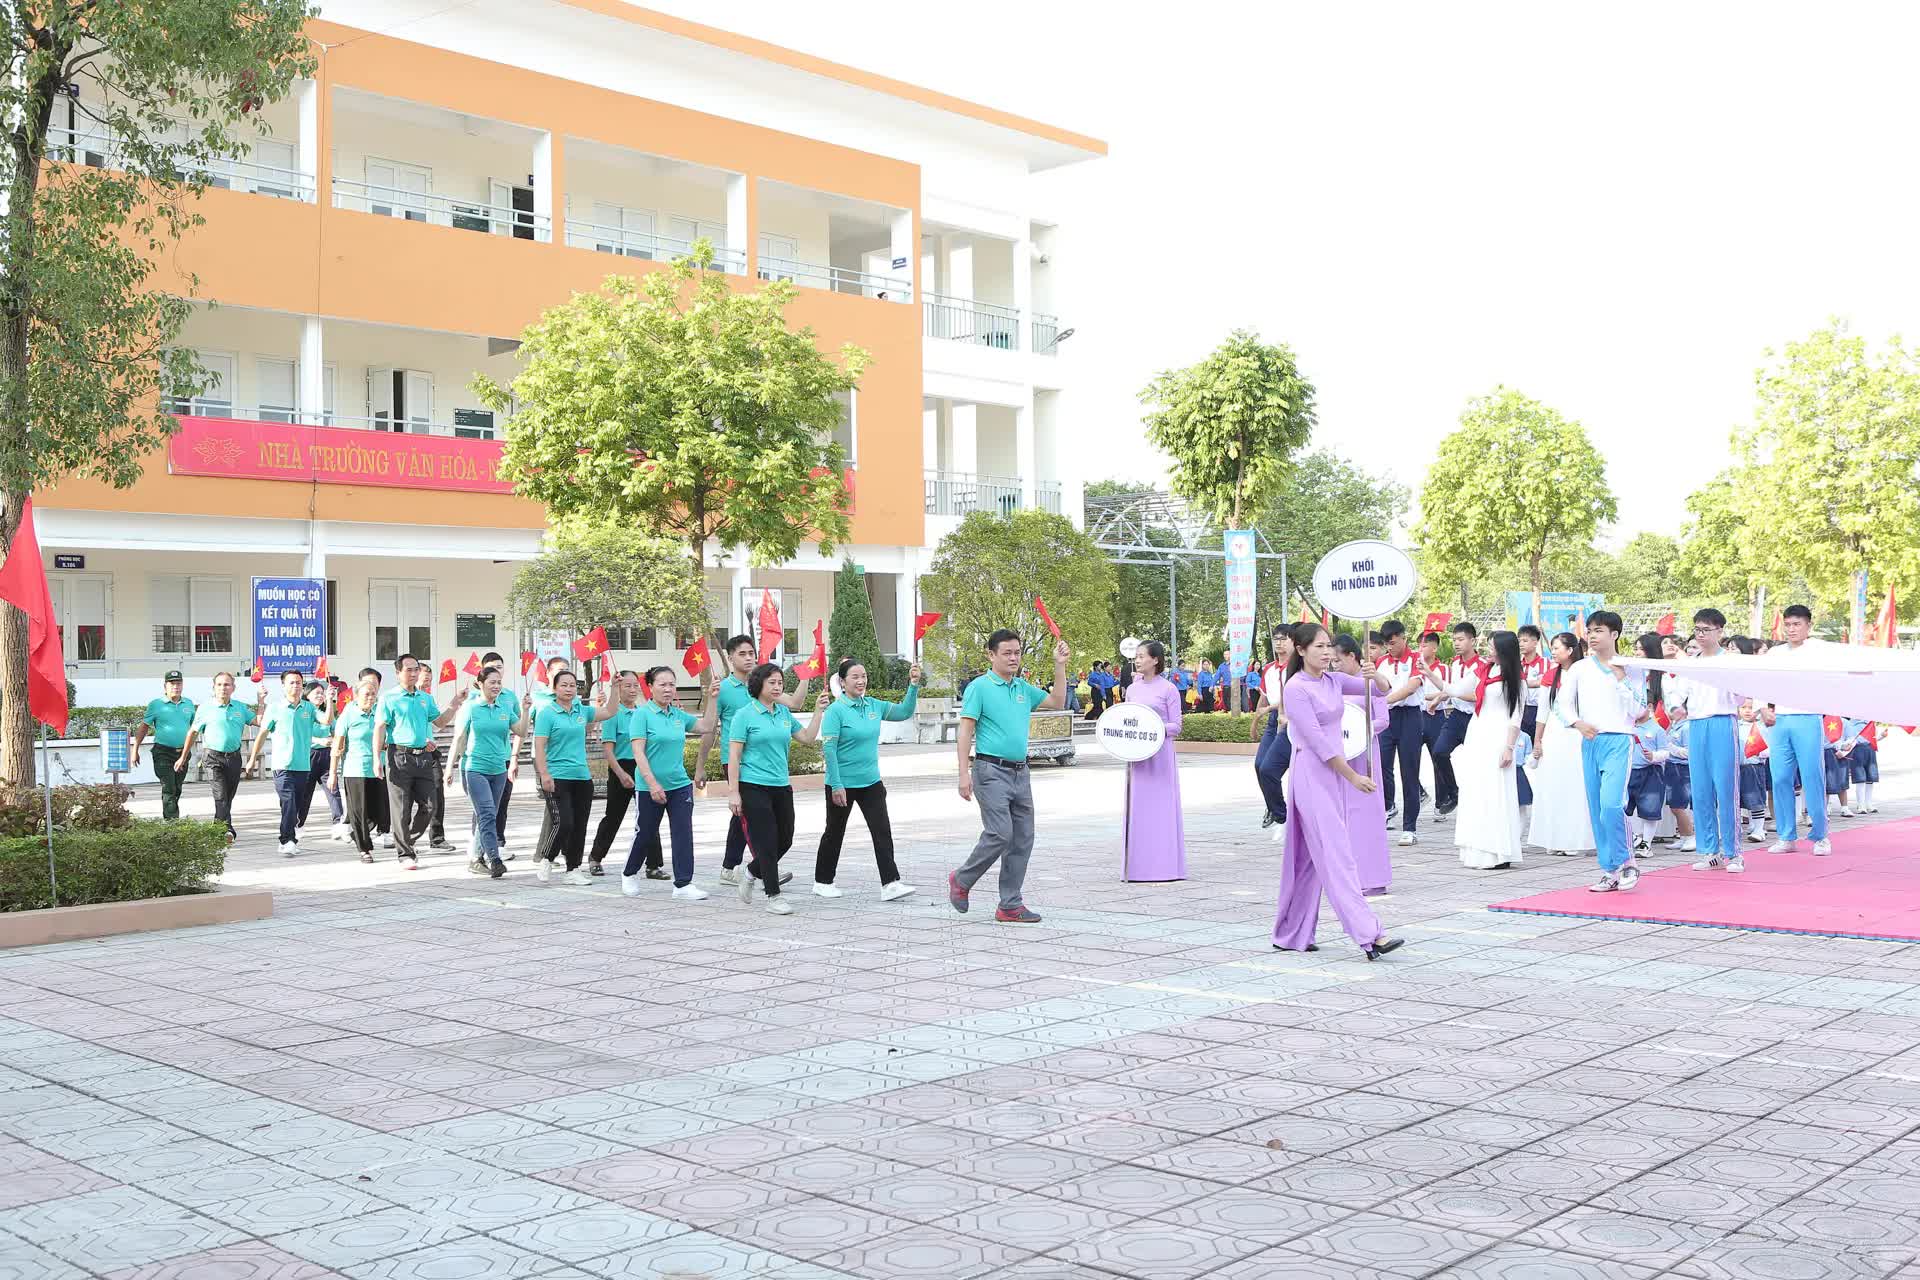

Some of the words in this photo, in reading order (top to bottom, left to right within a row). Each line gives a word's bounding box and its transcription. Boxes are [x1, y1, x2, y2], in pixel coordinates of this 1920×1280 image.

[257, 435, 305, 470] NHÀ
[309, 440, 390, 475] TRƯỜNG
[396, 448, 435, 479] VĂN
[440, 448, 478, 481] HÓA
[1352, 556, 1375, 573] KHỐI
[1331, 577, 1347, 593] HỘI
[1349, 575, 1375, 590] NÔNG
[1378, 572, 1398, 587] DÂN
[258, 585, 286, 601] MUỐN
[288, 589, 306, 603] HỌC
[308, 588, 320, 601] CÓ
[261, 604, 278, 619] KẾT
[280, 604, 299, 620] QUẢ
[301, 604, 317, 619] TỐT
[263, 623, 278, 638] THÌ
[280, 622, 302, 638] PHẢI
[303, 624, 316, 638] CÓ
[259, 642, 279, 657] THÁI
[281, 642, 294, 659] ĐỘ
[296, 642, 321, 657] ĐÚNG
[1123, 716, 1139, 728] KHỐI
[1103, 727, 1124, 738] TRUNG
[1125, 730, 1138, 741] HỌC
